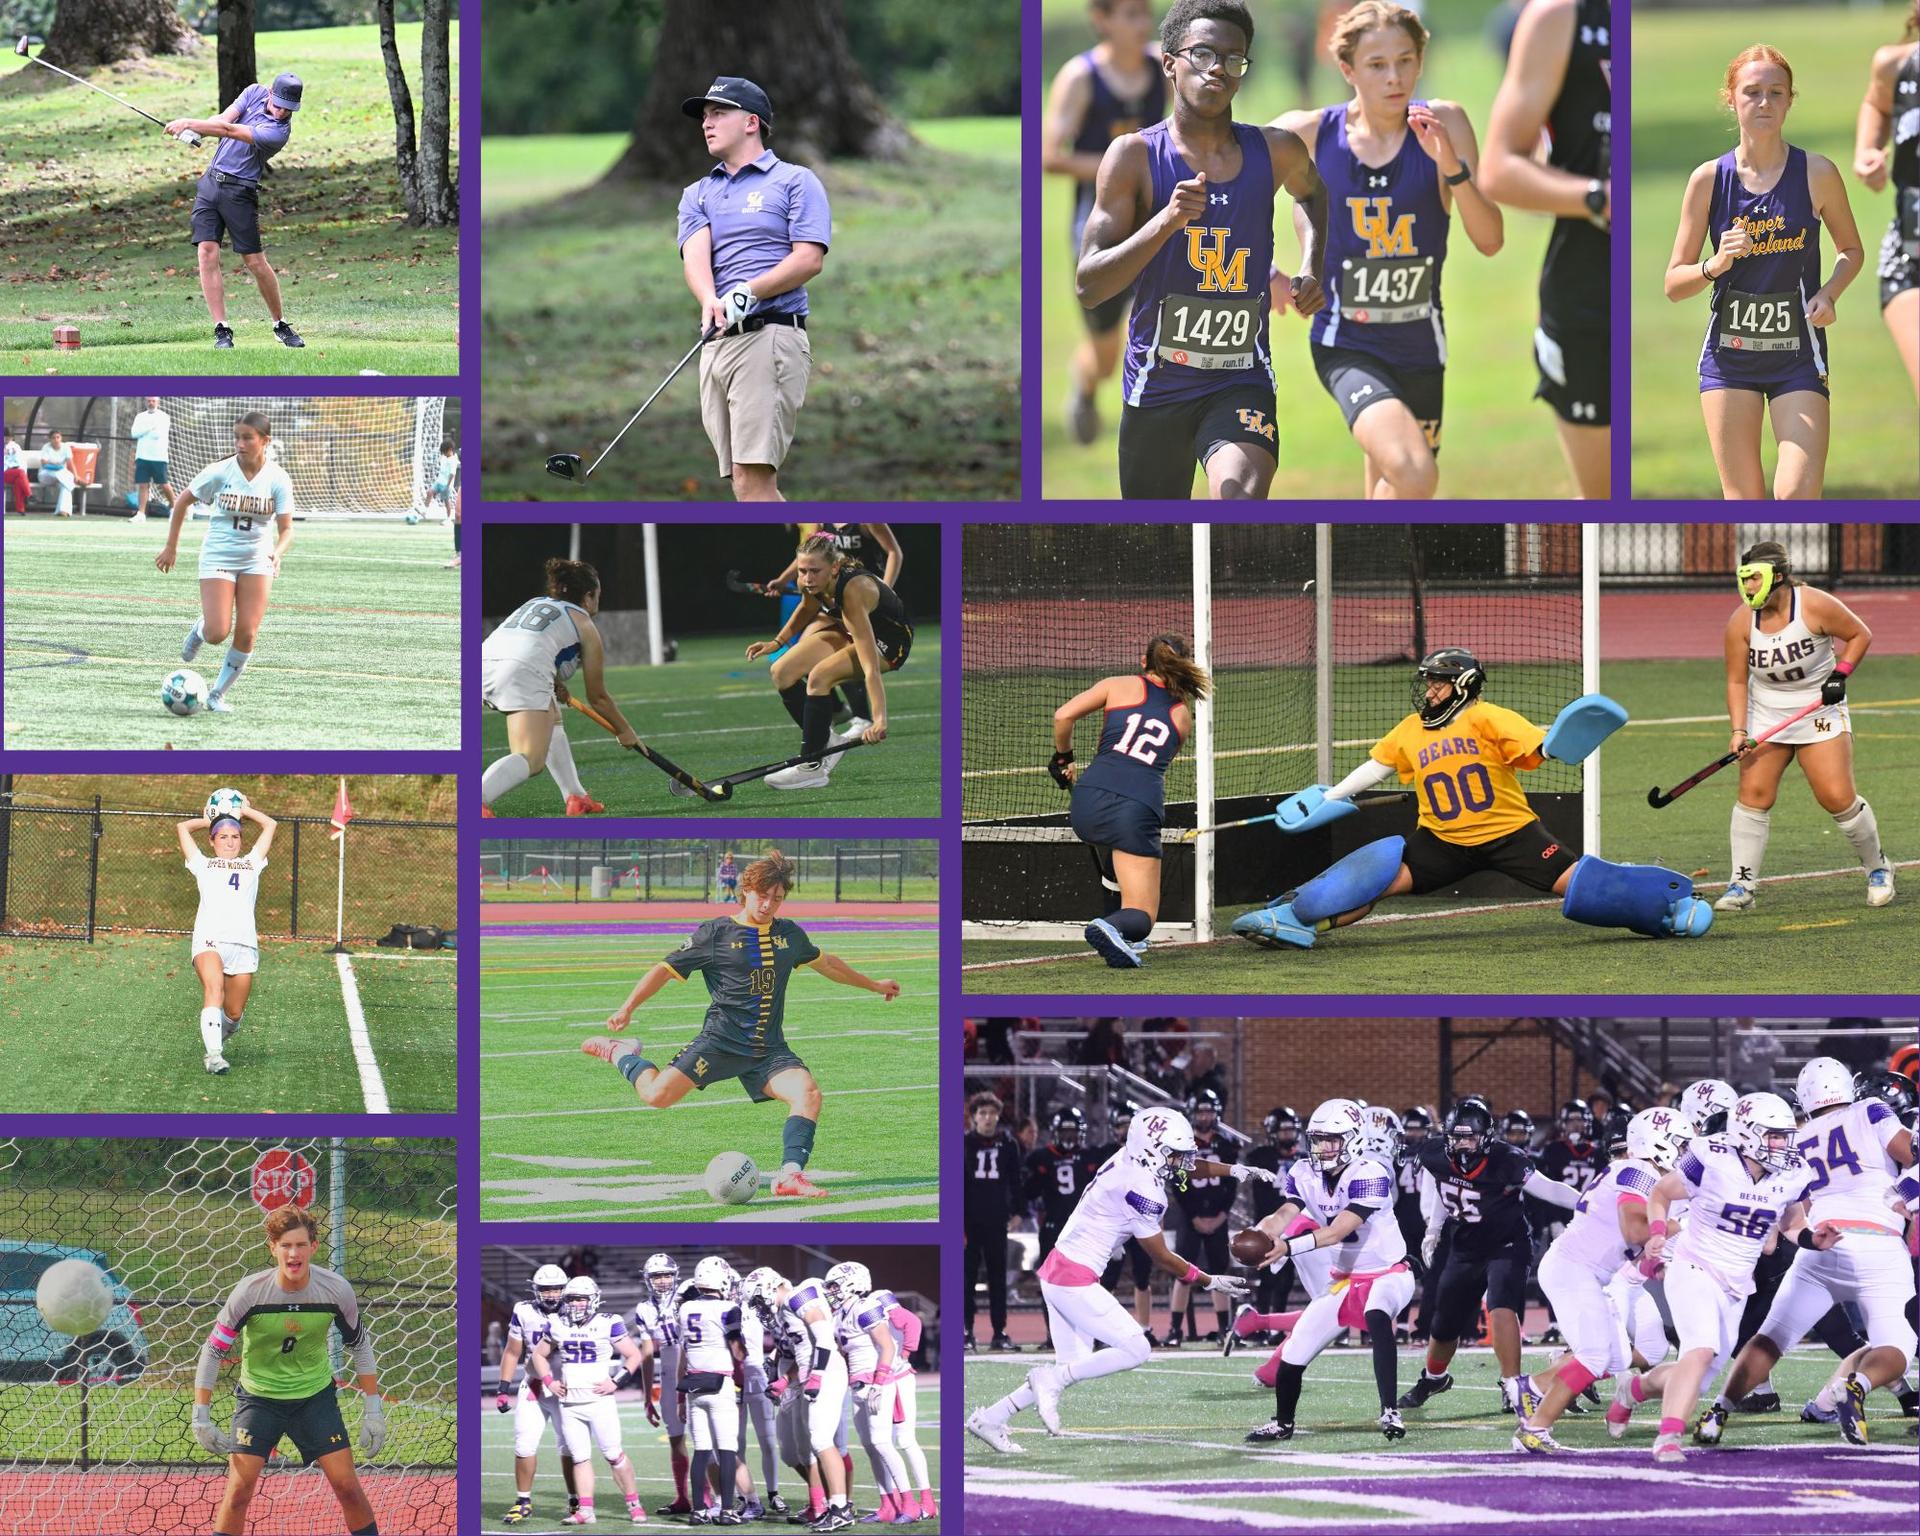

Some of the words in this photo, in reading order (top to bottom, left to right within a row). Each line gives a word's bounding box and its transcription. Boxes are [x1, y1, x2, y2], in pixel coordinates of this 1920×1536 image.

[1346, 196, 1418, 259] UM
[1184, 226, 1251, 293] UM
[1353, 266, 1425, 303] 1437
[1172, 306, 1251, 347] 1429
[1729, 299, 1791, 333] 1425
[1236, 408, 1275, 441] UM
[232, 516, 253, 531] 13
[833, 535, 862, 549] ARS
[503, 602, 562, 632] 18
[1749, 637, 1816, 669] BEARS
[1112, 712, 1171, 766] 12
[1814, 717, 1832, 733] UM
[1417, 736, 1480, 769] BEARS
[1423, 762, 1496, 822] 00
[228, 872, 240, 891] 4
[751, 967, 777, 996] 19
[1652, 1111, 1672, 1133] UM
[731, 1160, 753, 1185] SELECT
[974, 1147, 1000, 1179] 11
[1797, 1125, 1864, 1192] 54
[255, 1170, 310, 1199] STOP
[1056, 1165, 1076, 1195] 9
[1562, 1166, 1596, 1194] 27
[1440, 1181, 1483, 1223] 55
[1739, 1192, 1769, 1204] BEARS
[1716, 1203, 1777, 1240] 56
[687, 1313, 703, 1344] 5
[563, 1340, 598, 1364] 56
